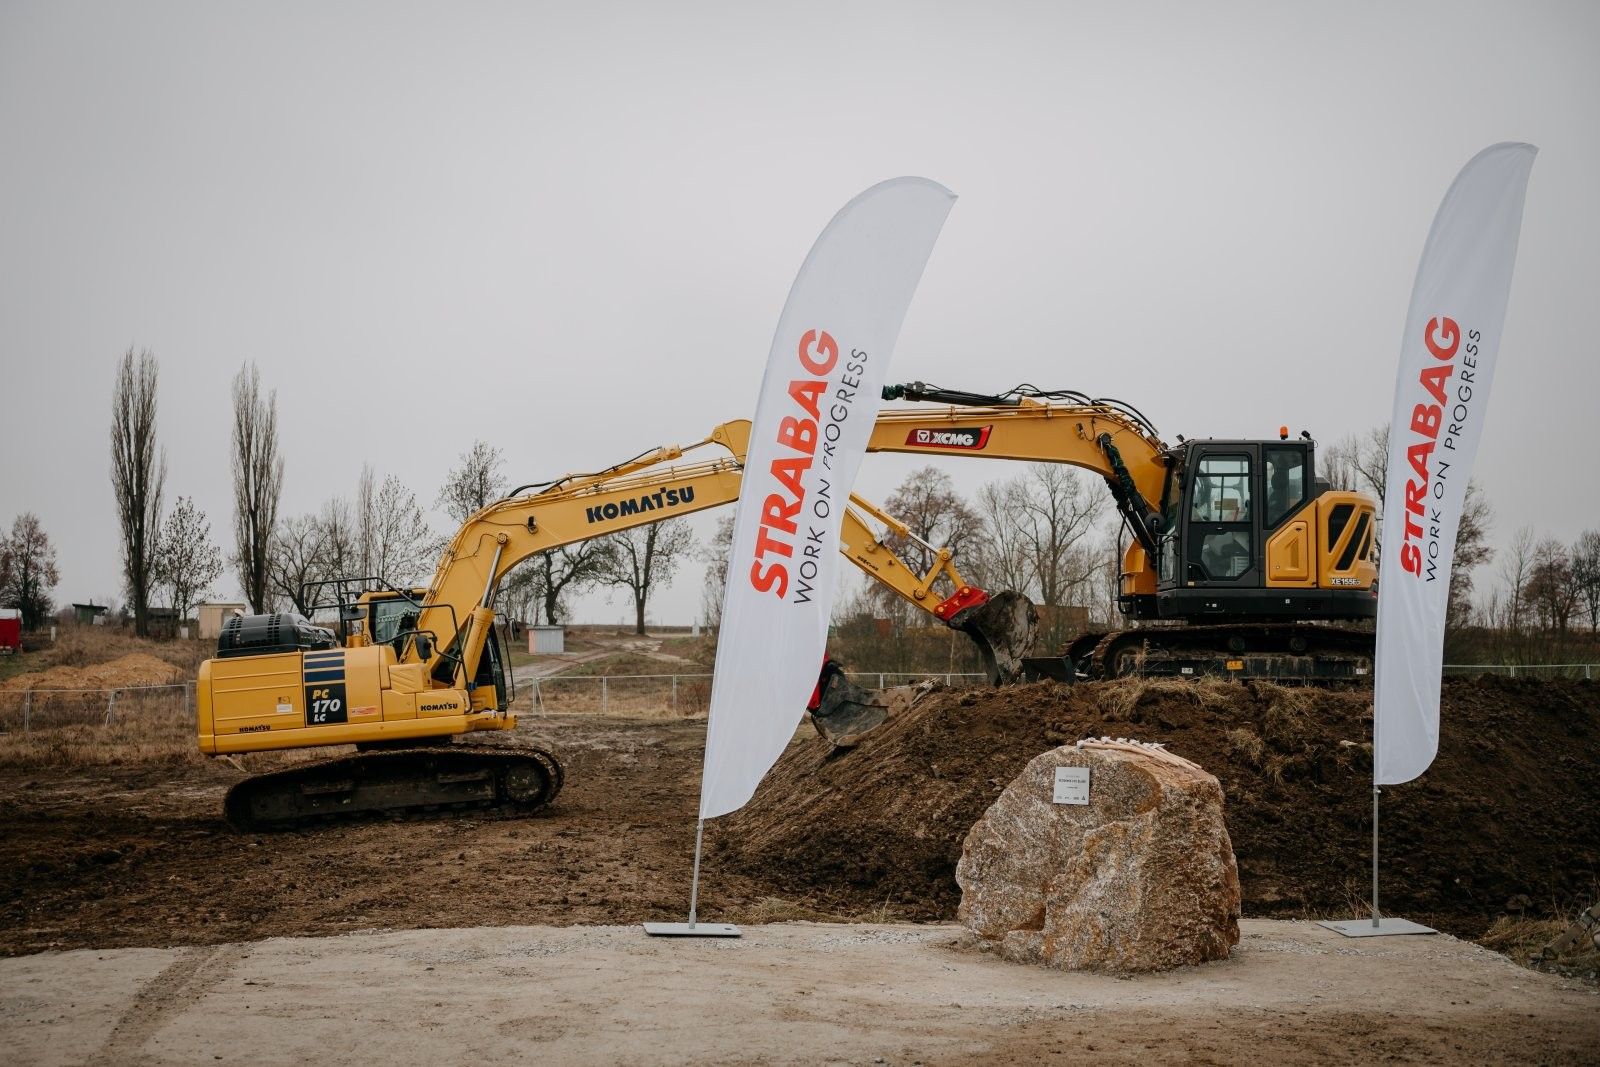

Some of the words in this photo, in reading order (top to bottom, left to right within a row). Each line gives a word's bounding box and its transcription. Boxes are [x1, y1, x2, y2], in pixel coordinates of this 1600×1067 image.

[822, 348, 868, 470] PROGRESS
[1443, 328, 1481, 451] PROGRESS
[930, 432, 974, 446] XCMG
[1400, 316, 1461, 578] STRABAG
[750, 329, 838, 599] STRABAG
[1433, 460, 1450, 500] ON
[586, 486, 695, 524] KOMATSU
[814, 478, 831, 519] ON
[793, 526, 826, 604] WORK
[1426, 508, 1442, 582] WORK
[312, 688, 330, 700] PC
[312, 698, 341, 713] 170
[420, 702, 458, 711] KOMATSU
[239, 725, 271, 733] KOMATSU
[313, 713, 327, 723] LC
